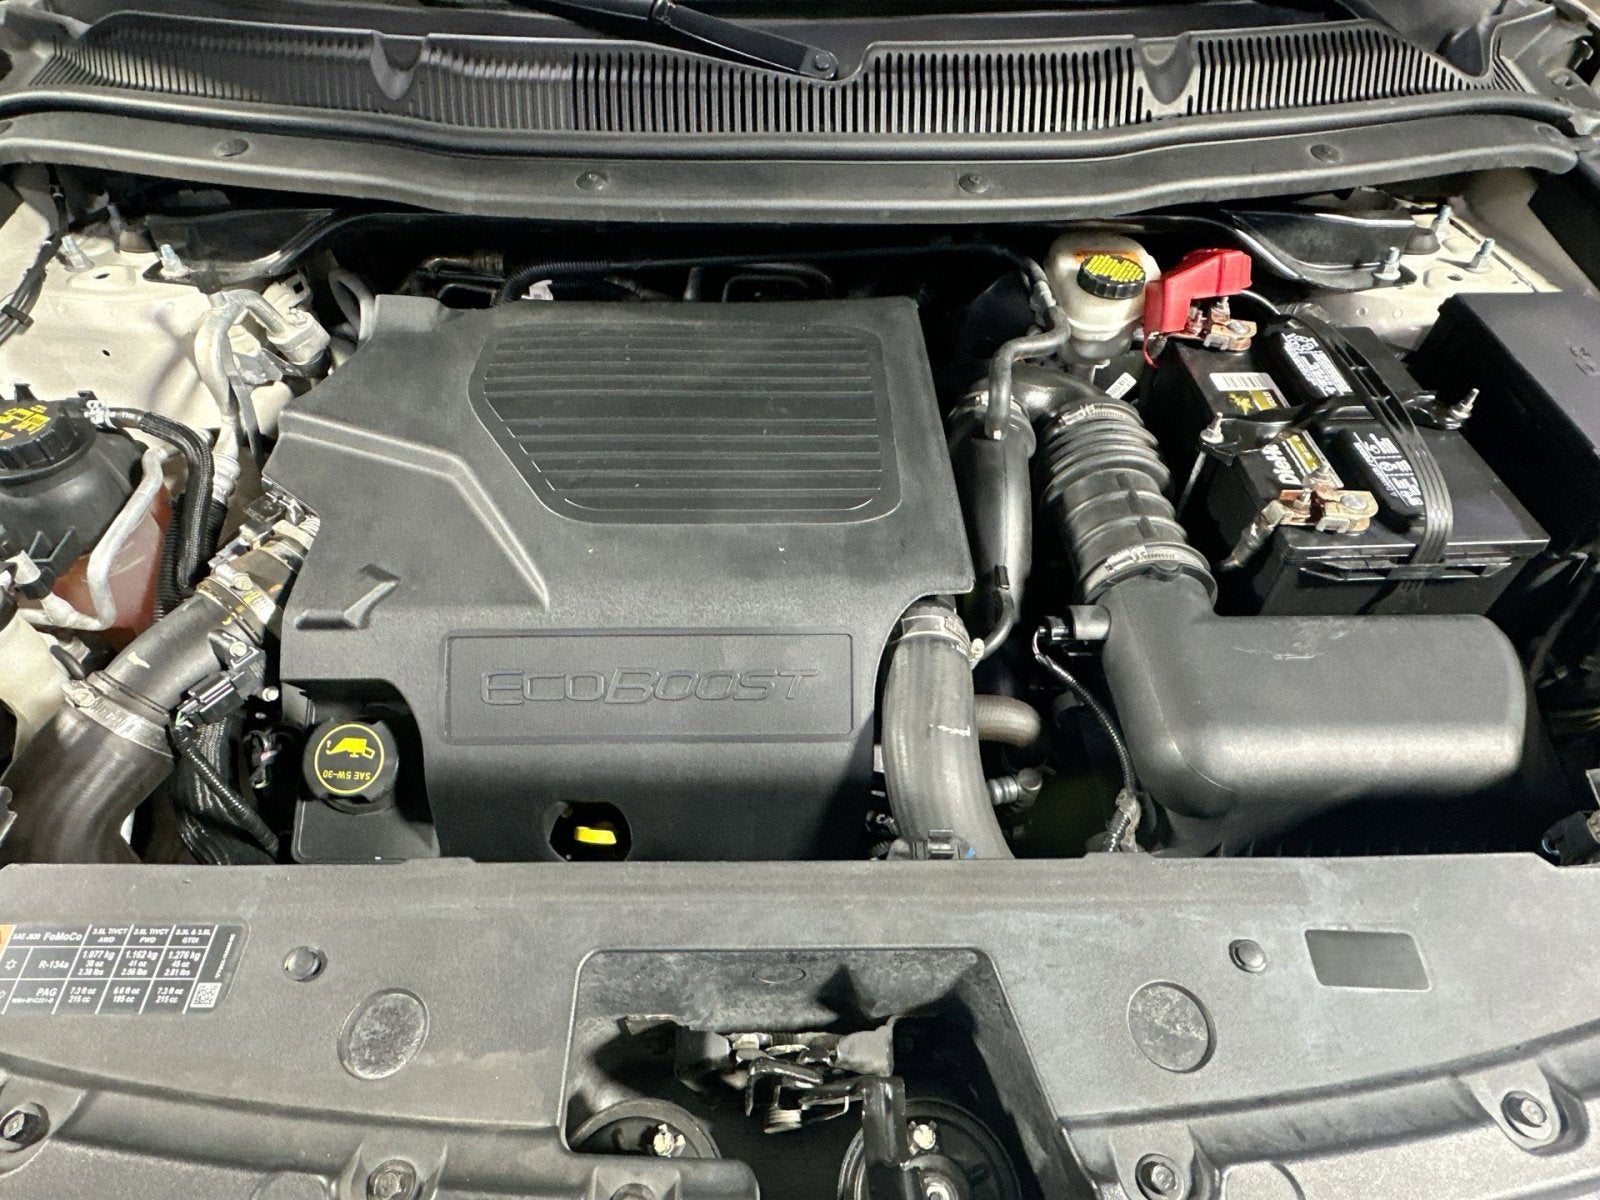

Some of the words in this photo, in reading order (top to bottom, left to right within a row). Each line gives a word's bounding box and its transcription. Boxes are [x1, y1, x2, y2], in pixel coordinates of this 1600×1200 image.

[1262, 444, 1302, 485] DieHa
[322, 769, 352, 780] 5W-30
[354, 771, 372, 781] SAE
[43, 931, 83, 941] FoMoCo
[82, 950, 104, 959] 1.077
[104, 950, 115, 961] kg
[125, 950, 146, 959] 1.162
[147, 950, 159, 961] kg
[168, 950, 190, 960] 1.276
[190, 951, 201, 961] kg
[38, 960, 70, 969] R-134a
[171, 960, 181, 968] 45
[36, 988, 58, 997] PAG
[68, 995, 81, 1003] 215
[155, 995, 169, 1003] 215
